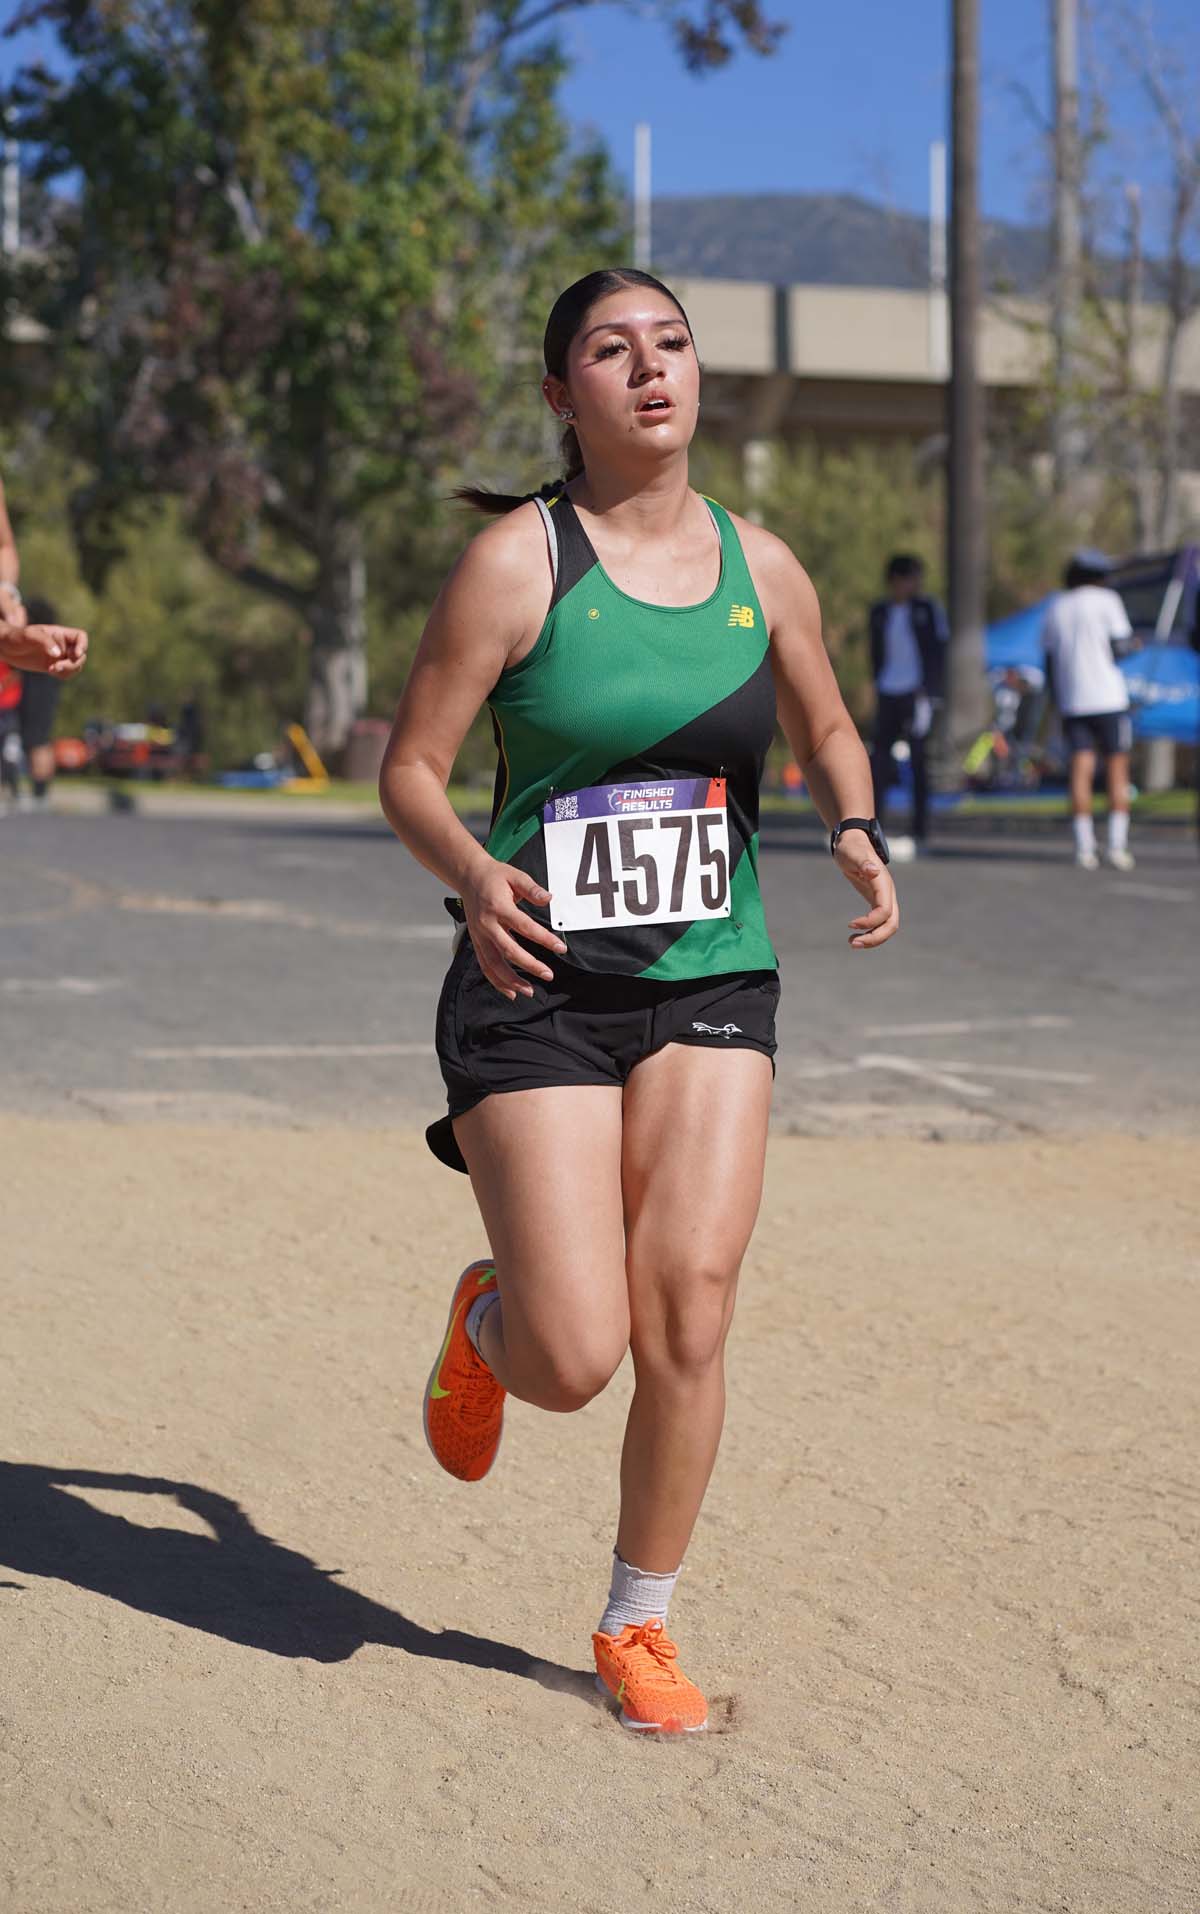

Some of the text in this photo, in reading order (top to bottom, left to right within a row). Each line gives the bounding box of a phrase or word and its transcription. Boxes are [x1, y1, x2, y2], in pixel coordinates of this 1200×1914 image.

[624, 787, 674, 799] FINISHED
[622, 800, 673, 812] RESULTS
[575, 814, 728, 918] 4575
